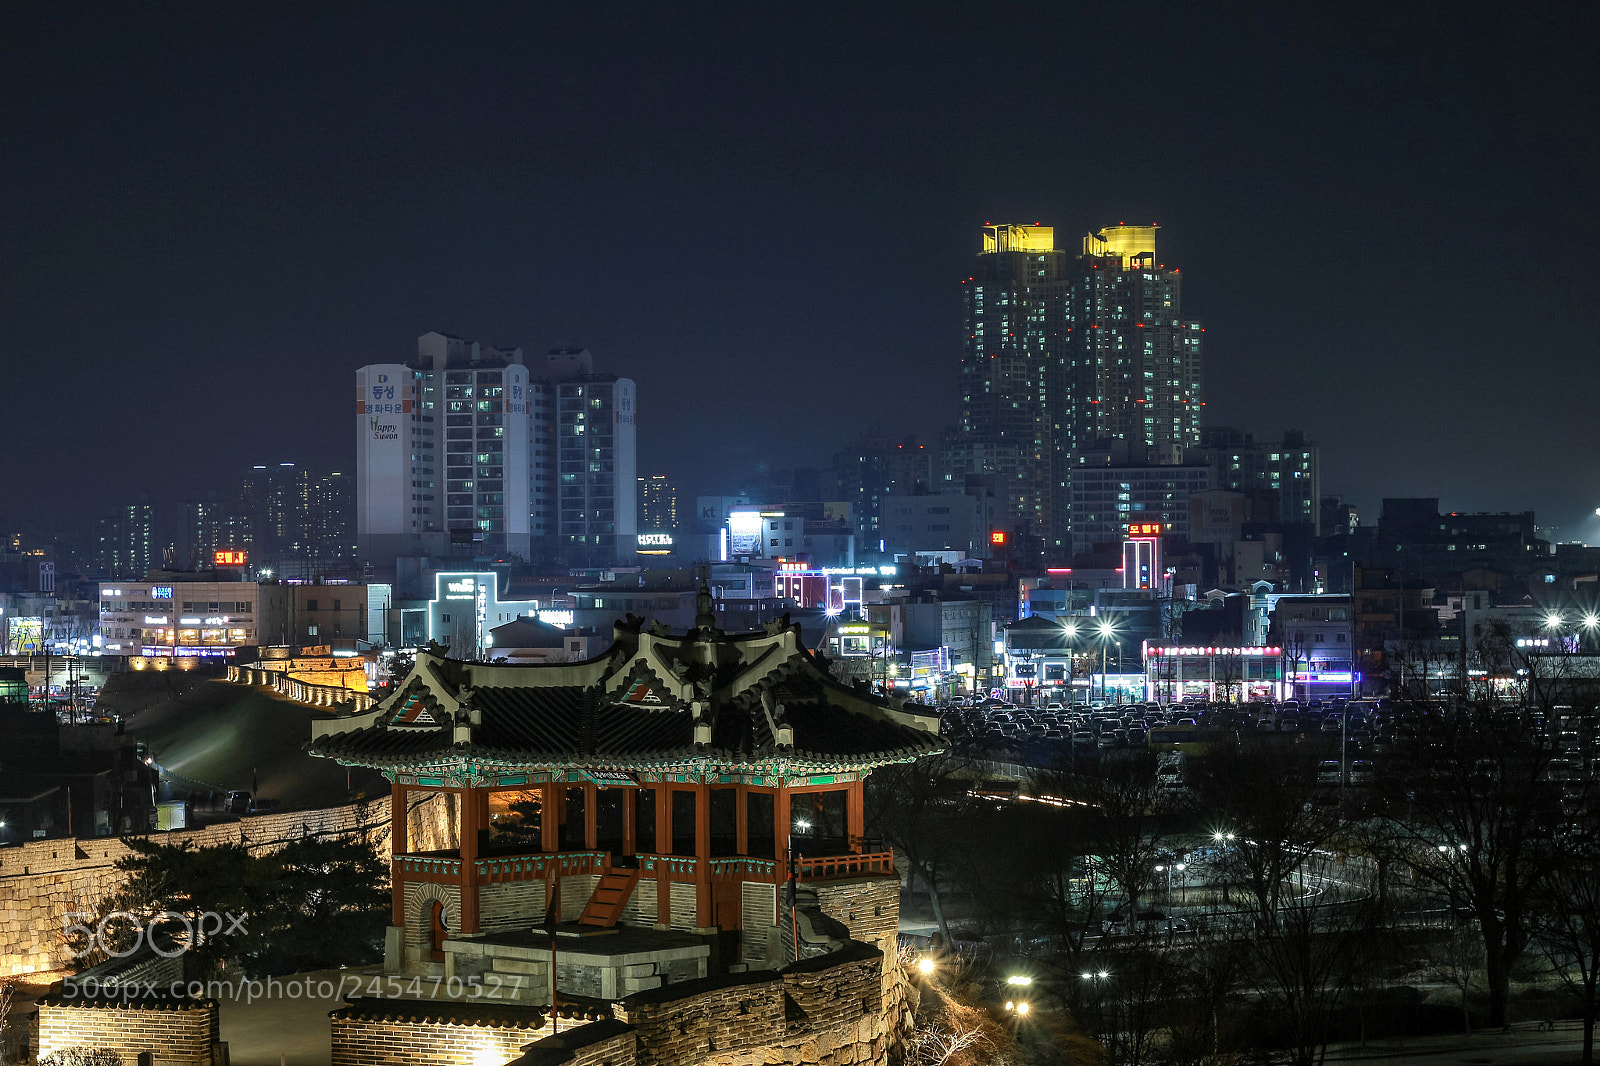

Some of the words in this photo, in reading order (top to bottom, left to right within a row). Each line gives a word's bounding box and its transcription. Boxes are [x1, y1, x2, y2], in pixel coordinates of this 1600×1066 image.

[372, 385, 395, 400] 동성
[369, 415, 398, 433] Happy
[372, 431, 399, 440] Suwon
[702, 506, 717, 518] kt
